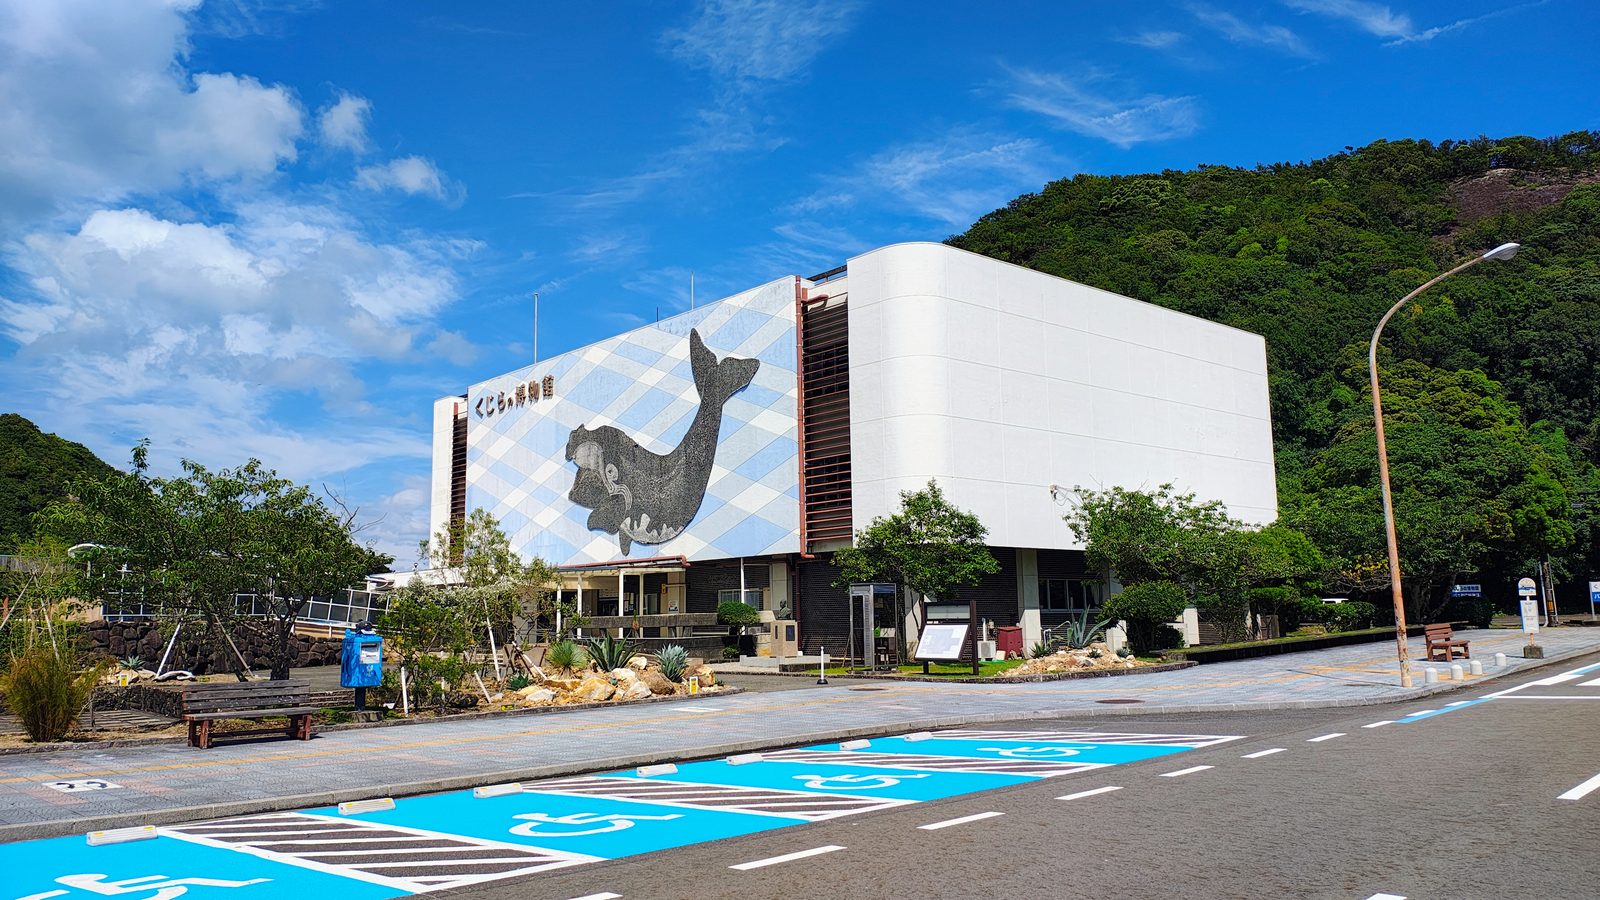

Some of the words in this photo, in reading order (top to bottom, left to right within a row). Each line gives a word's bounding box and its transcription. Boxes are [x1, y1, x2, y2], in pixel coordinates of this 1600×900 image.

[475, 374, 555, 417] くじらの博物館
